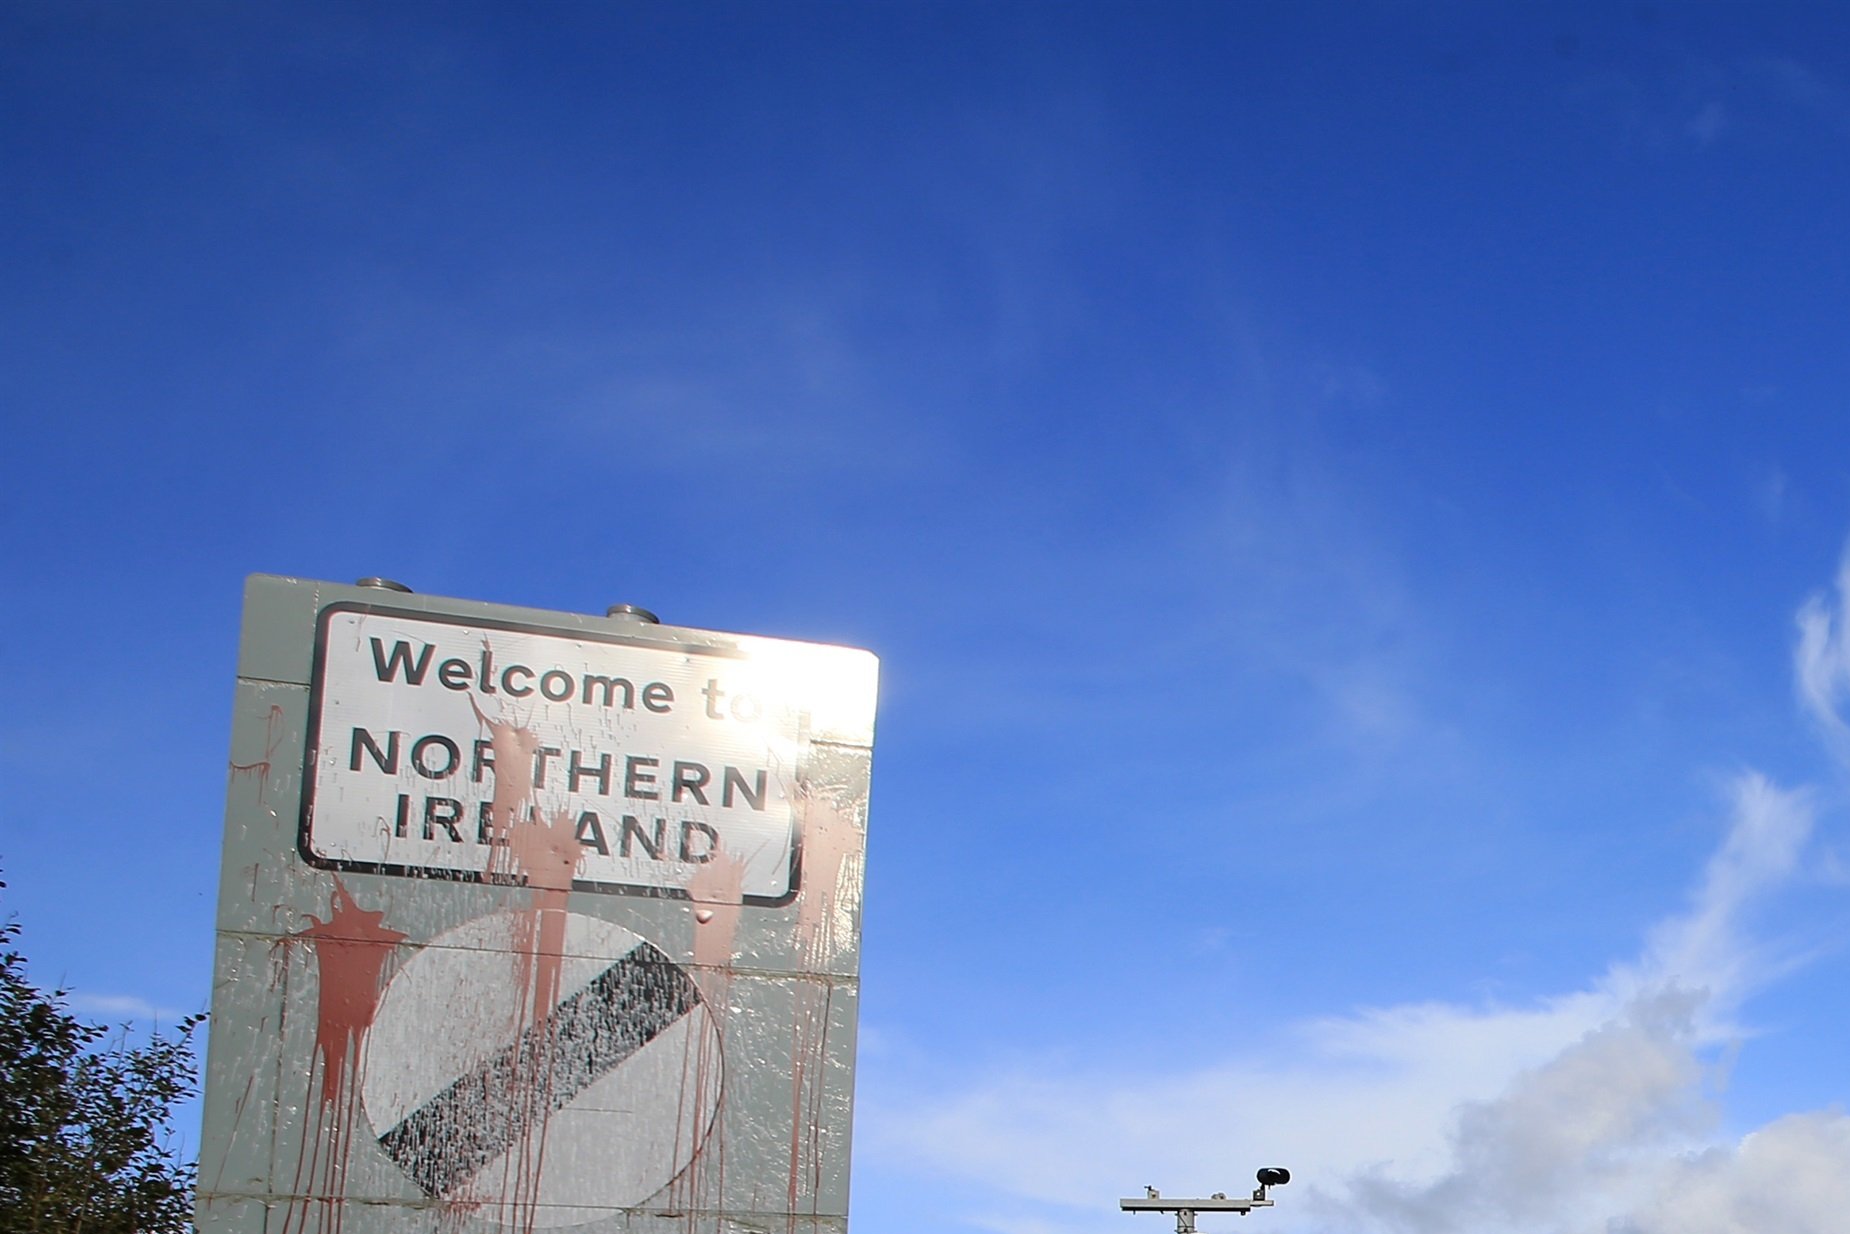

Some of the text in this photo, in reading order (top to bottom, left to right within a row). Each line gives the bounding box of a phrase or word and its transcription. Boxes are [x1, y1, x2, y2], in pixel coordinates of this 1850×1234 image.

[369, 637, 763, 723] Welcome to
[394, 793, 722, 865] IREAND
